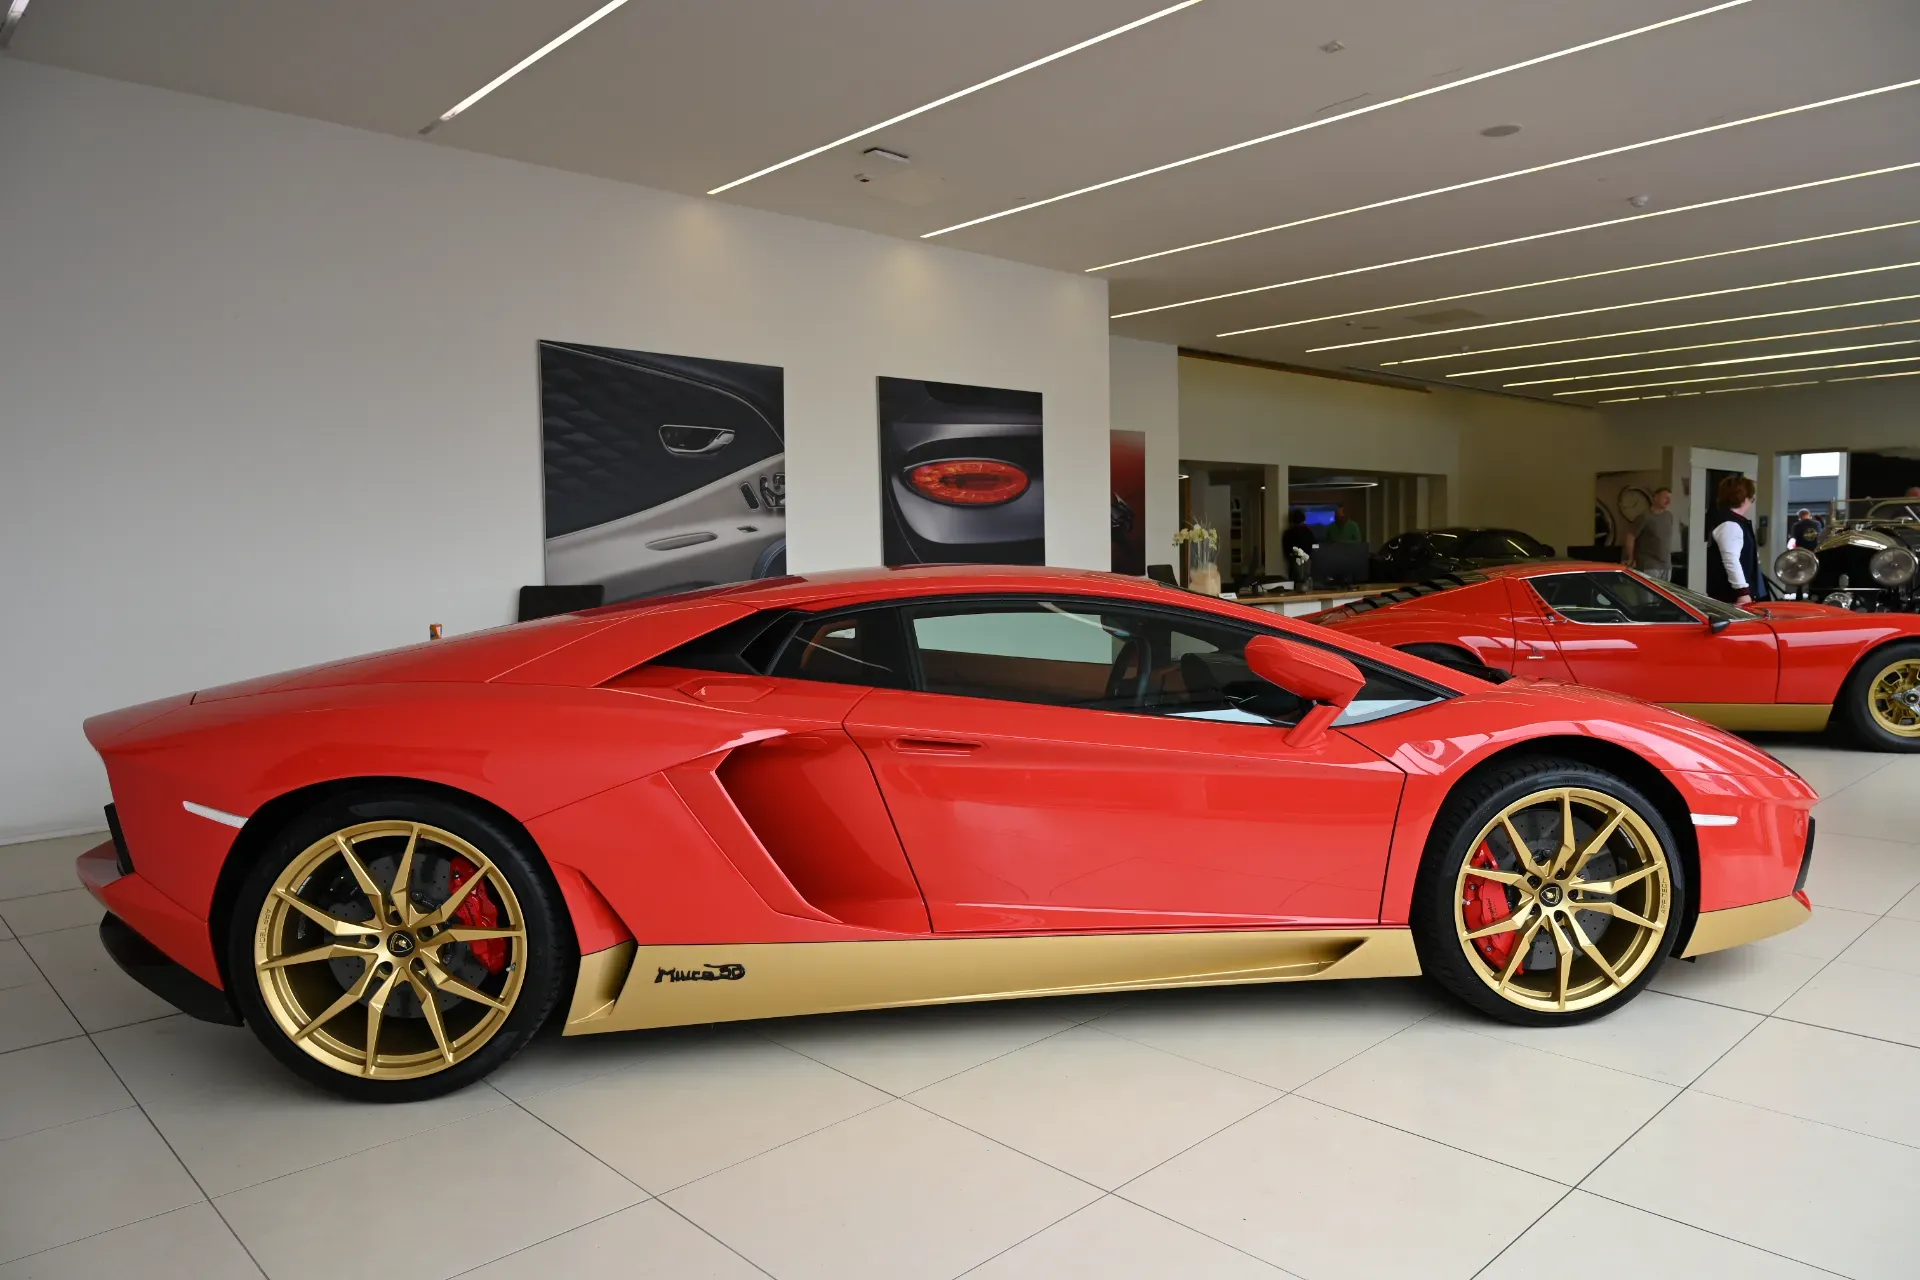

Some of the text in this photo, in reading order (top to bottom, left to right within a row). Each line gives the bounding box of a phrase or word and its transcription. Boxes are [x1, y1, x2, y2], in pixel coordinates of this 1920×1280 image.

[1660, 878, 1668, 898] TECH
[259, 926, 268, 949] TECH
[654, 966, 715, 983] Miura
